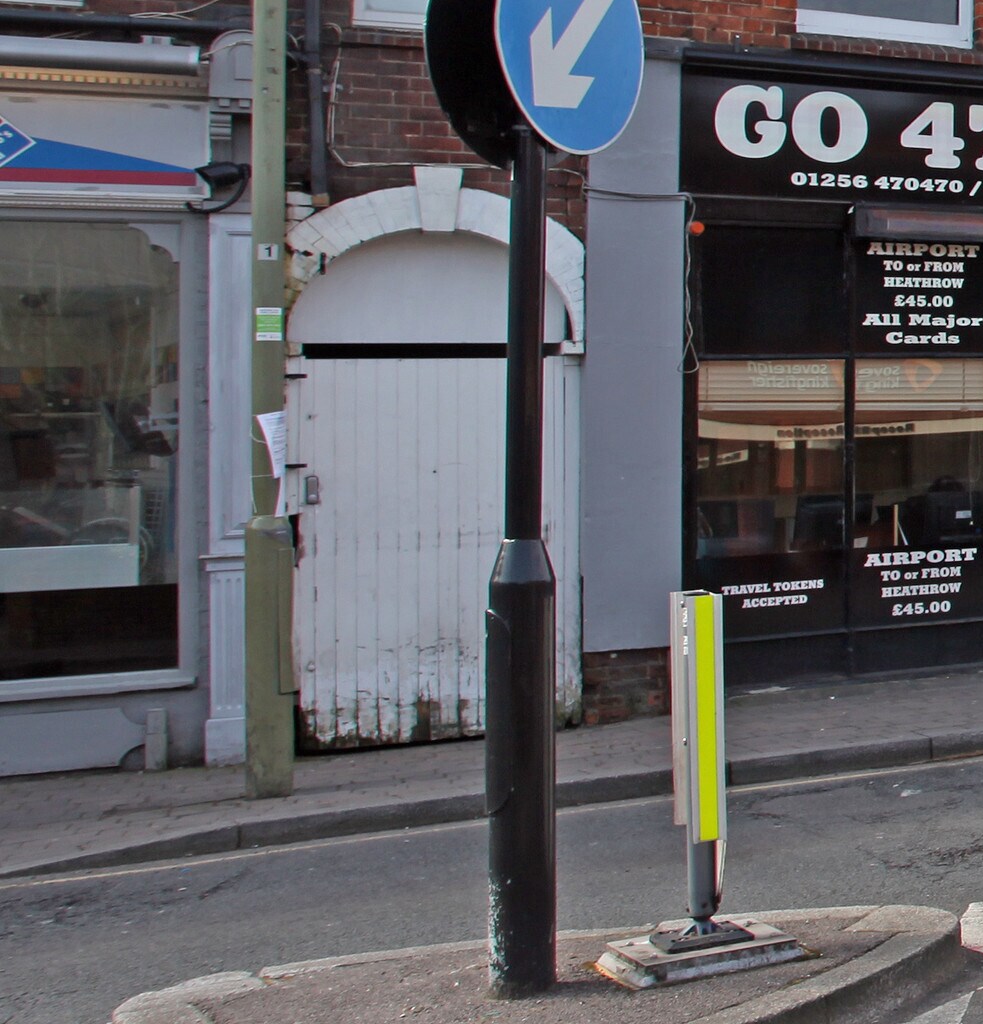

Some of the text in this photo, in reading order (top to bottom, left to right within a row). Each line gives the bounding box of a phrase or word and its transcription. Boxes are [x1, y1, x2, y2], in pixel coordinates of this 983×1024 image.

[714, 84, 868, 164] GO
[790, 171, 868, 189] 01256
[873, 176, 964, 193] 470470
[968, 180, 982, 197] /
[264, 246, 272, 257] 1
[866, 241, 979, 259] AIRPORT
[883, 260, 965, 273] TO or FROM
[883, 276, 965, 289] HEATHROW
[894, 294, 954, 308] £45.00
[861, 313, 983, 329] All Major
[885, 331, 960, 345] Cards
[863, 547, 978, 568] AIRPORT
[880, 565, 962, 581] TO or FROM
[721, 578, 825, 596] TRAVEL TOKENS
[881, 582, 962, 598] HEATHROW
[741, 594, 808, 609] ACCEPTED
[891, 600, 951, 617] £45.00
